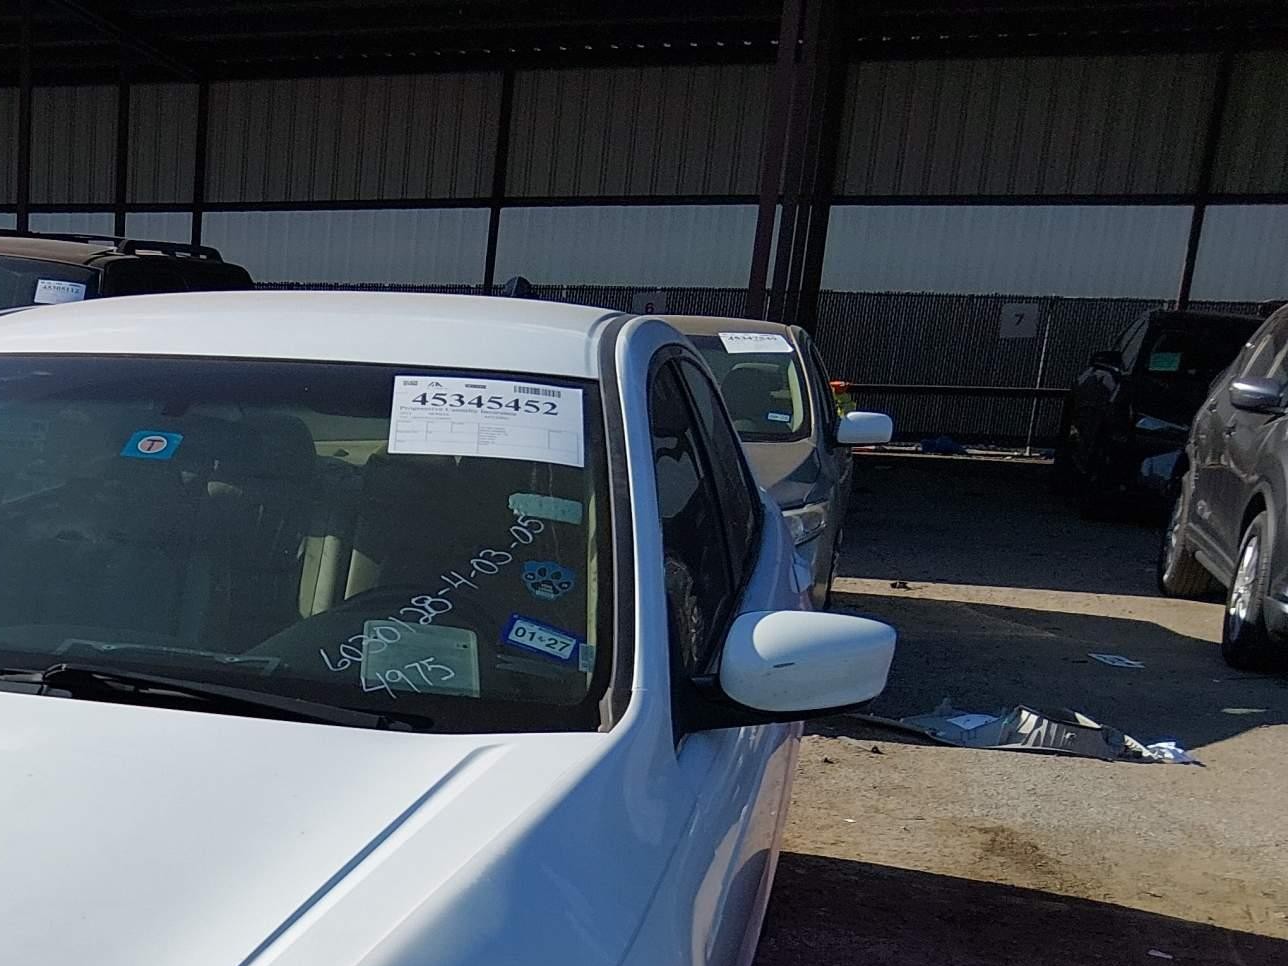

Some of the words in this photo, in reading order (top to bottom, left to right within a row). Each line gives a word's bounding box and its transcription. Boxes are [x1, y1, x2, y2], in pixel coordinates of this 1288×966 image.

[1014, 313, 1025, 326] 7
[412, 392, 559, 416] 45345452
[360, 657, 456, 700] 4975
